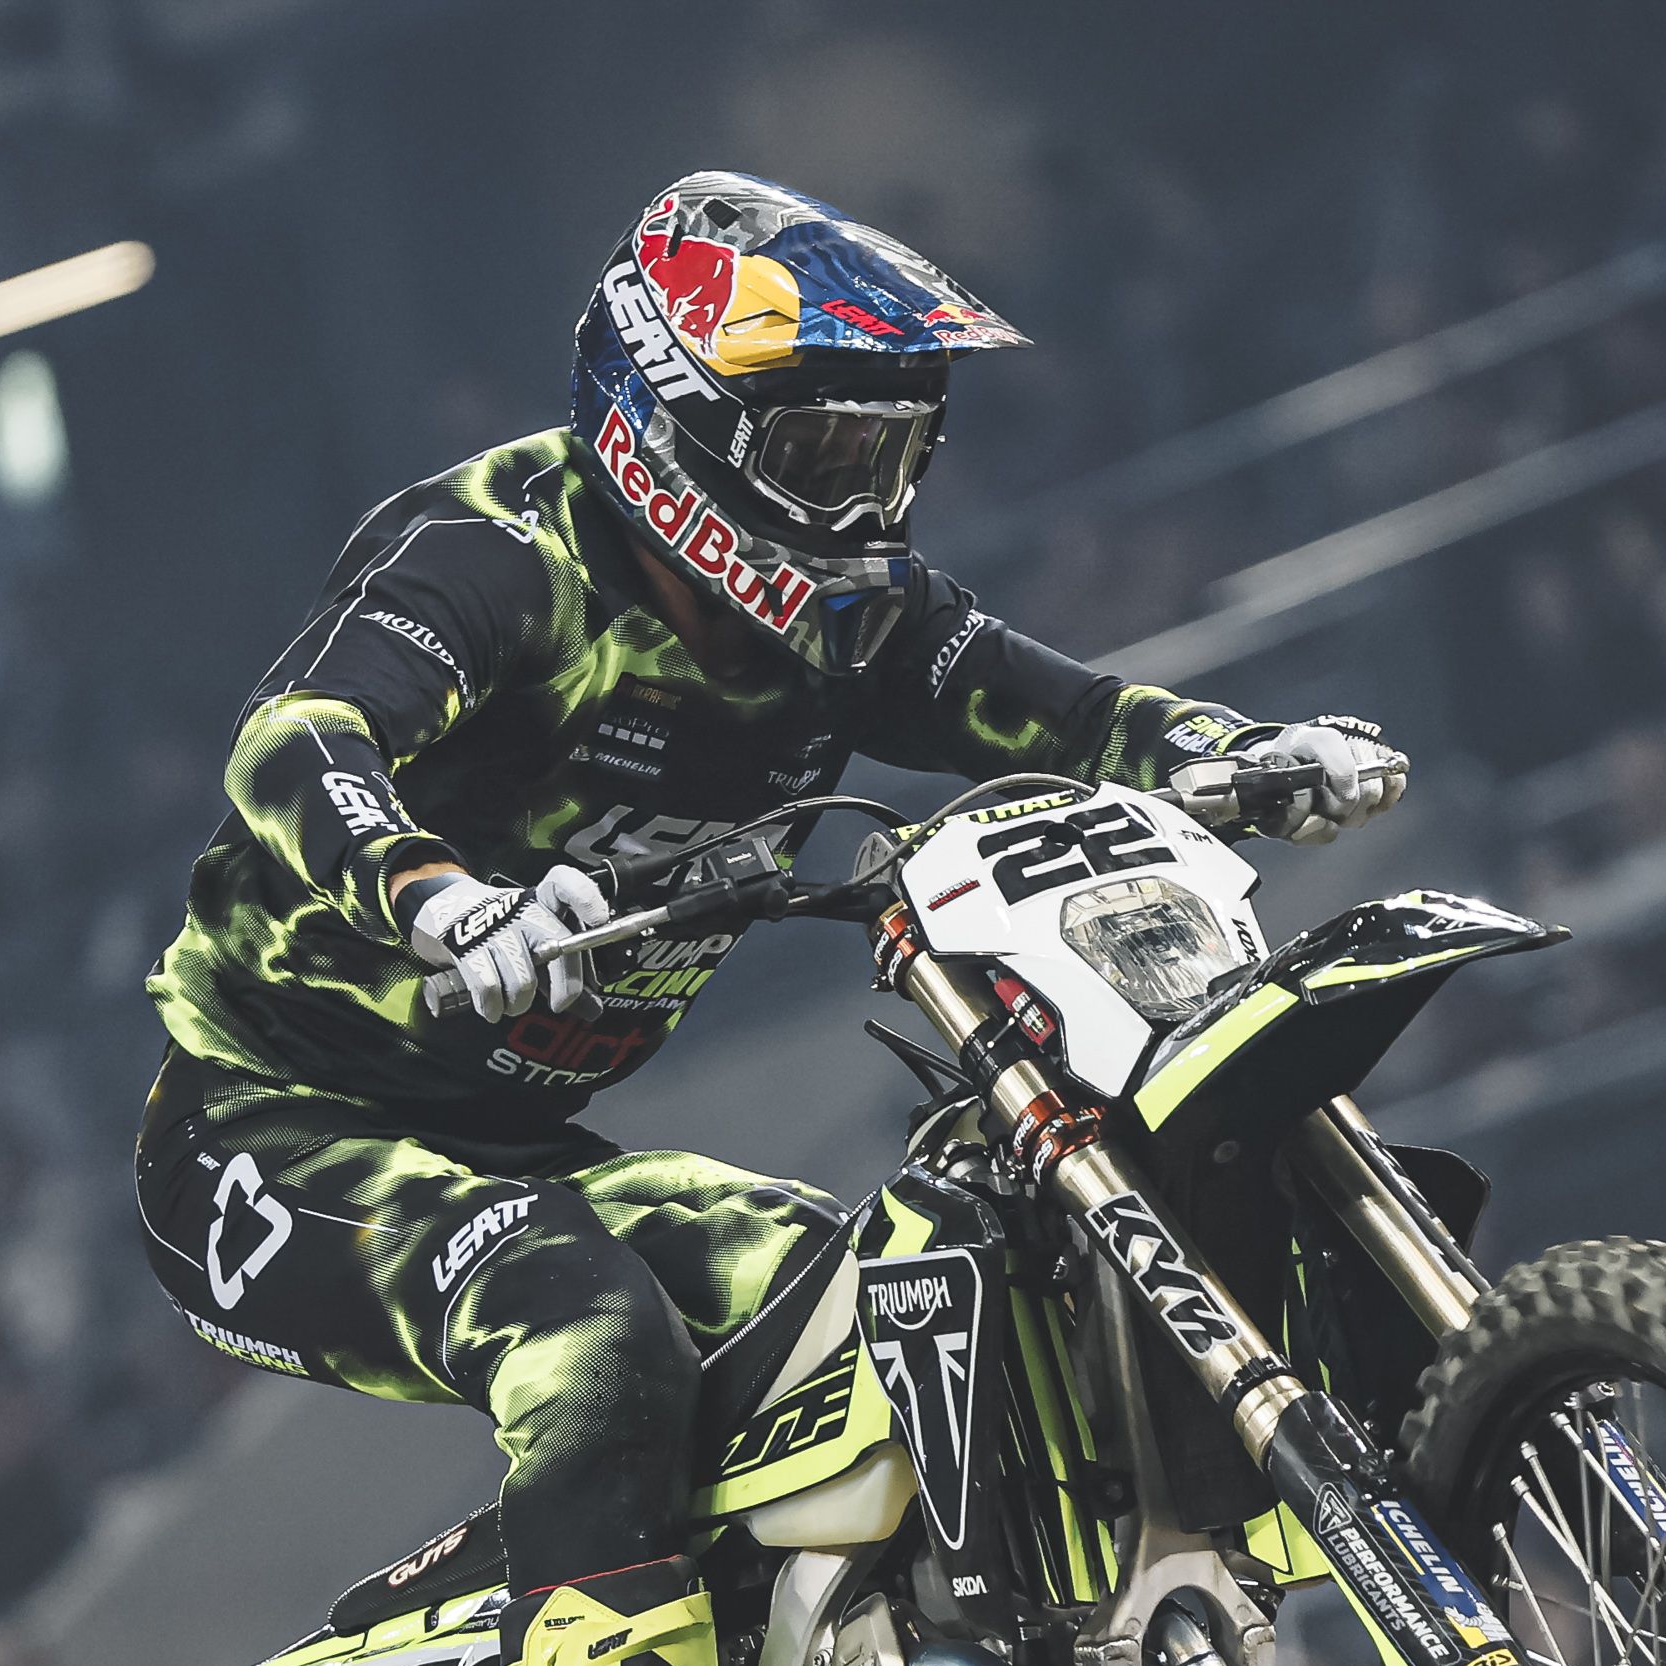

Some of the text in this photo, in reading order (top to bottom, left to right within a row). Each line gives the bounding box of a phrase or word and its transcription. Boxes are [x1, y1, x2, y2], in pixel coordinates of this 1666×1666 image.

[595, 405, 817, 635] Red Bull
[595, 752, 662, 776] MICHELIN
[977, 802, 1180, 906] 22
[185, 1309, 303, 1365] TRIUMPH
[867, 1276, 953, 1330] TRIUMPH
[387, 1528, 467, 1587] GUTS
[1330, 1535, 1406, 1632] LUBRICANTS
[1381, 1500, 1465, 1594] ICHELIN
[953, 1575, 988, 1597] SKDA
[1342, 1529, 1449, 1660] PERFORMANCE
